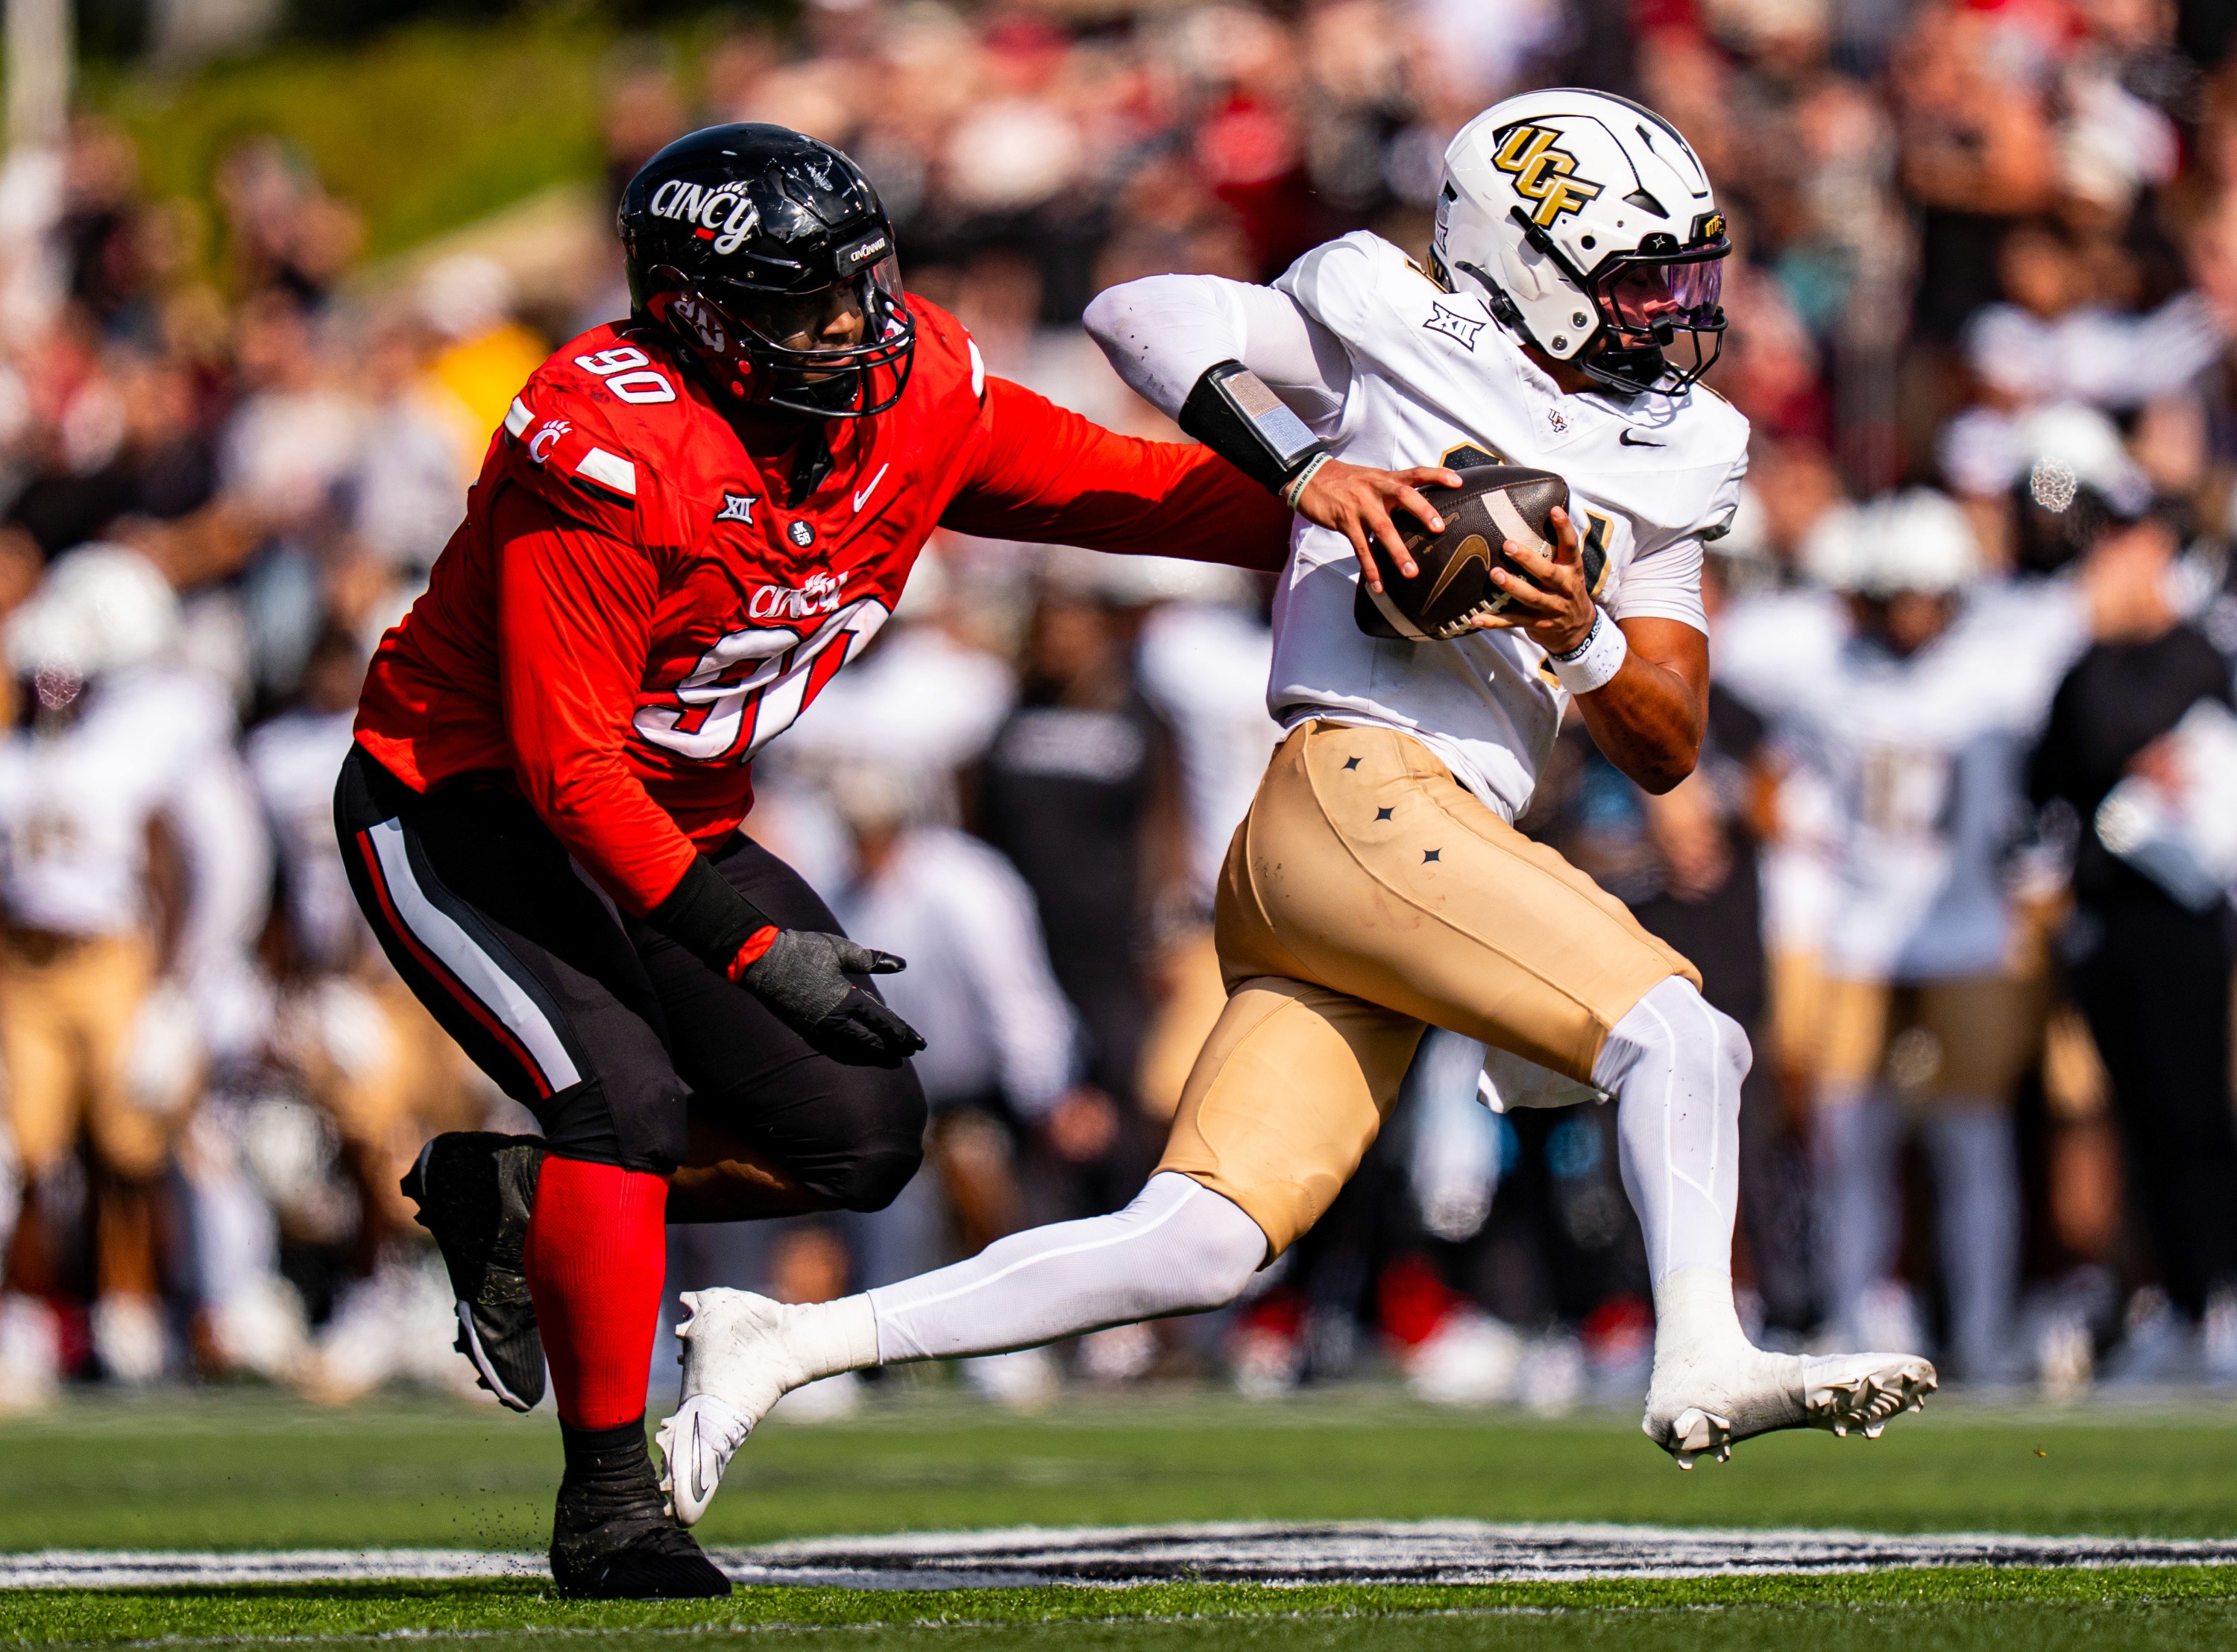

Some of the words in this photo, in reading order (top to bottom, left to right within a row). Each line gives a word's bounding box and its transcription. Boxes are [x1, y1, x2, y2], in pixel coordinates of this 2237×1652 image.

[1492, 124, 1605, 230] UCF
[651, 180, 760, 254] CINCY
[851, 237, 885, 262] CINCINNATI
[1423, 300, 1486, 353] XII
[574, 347, 676, 404] 90
[1548, 408, 1567, 432] UCF
[1290, 481, 1303, 502] MENTAL
[1302, 462, 1317, 482] HEALTH
[716, 493, 758, 526] XII
[793, 521, 808, 535] JK
[796, 532, 811, 546] 58
[633, 596, 891, 763] 90
